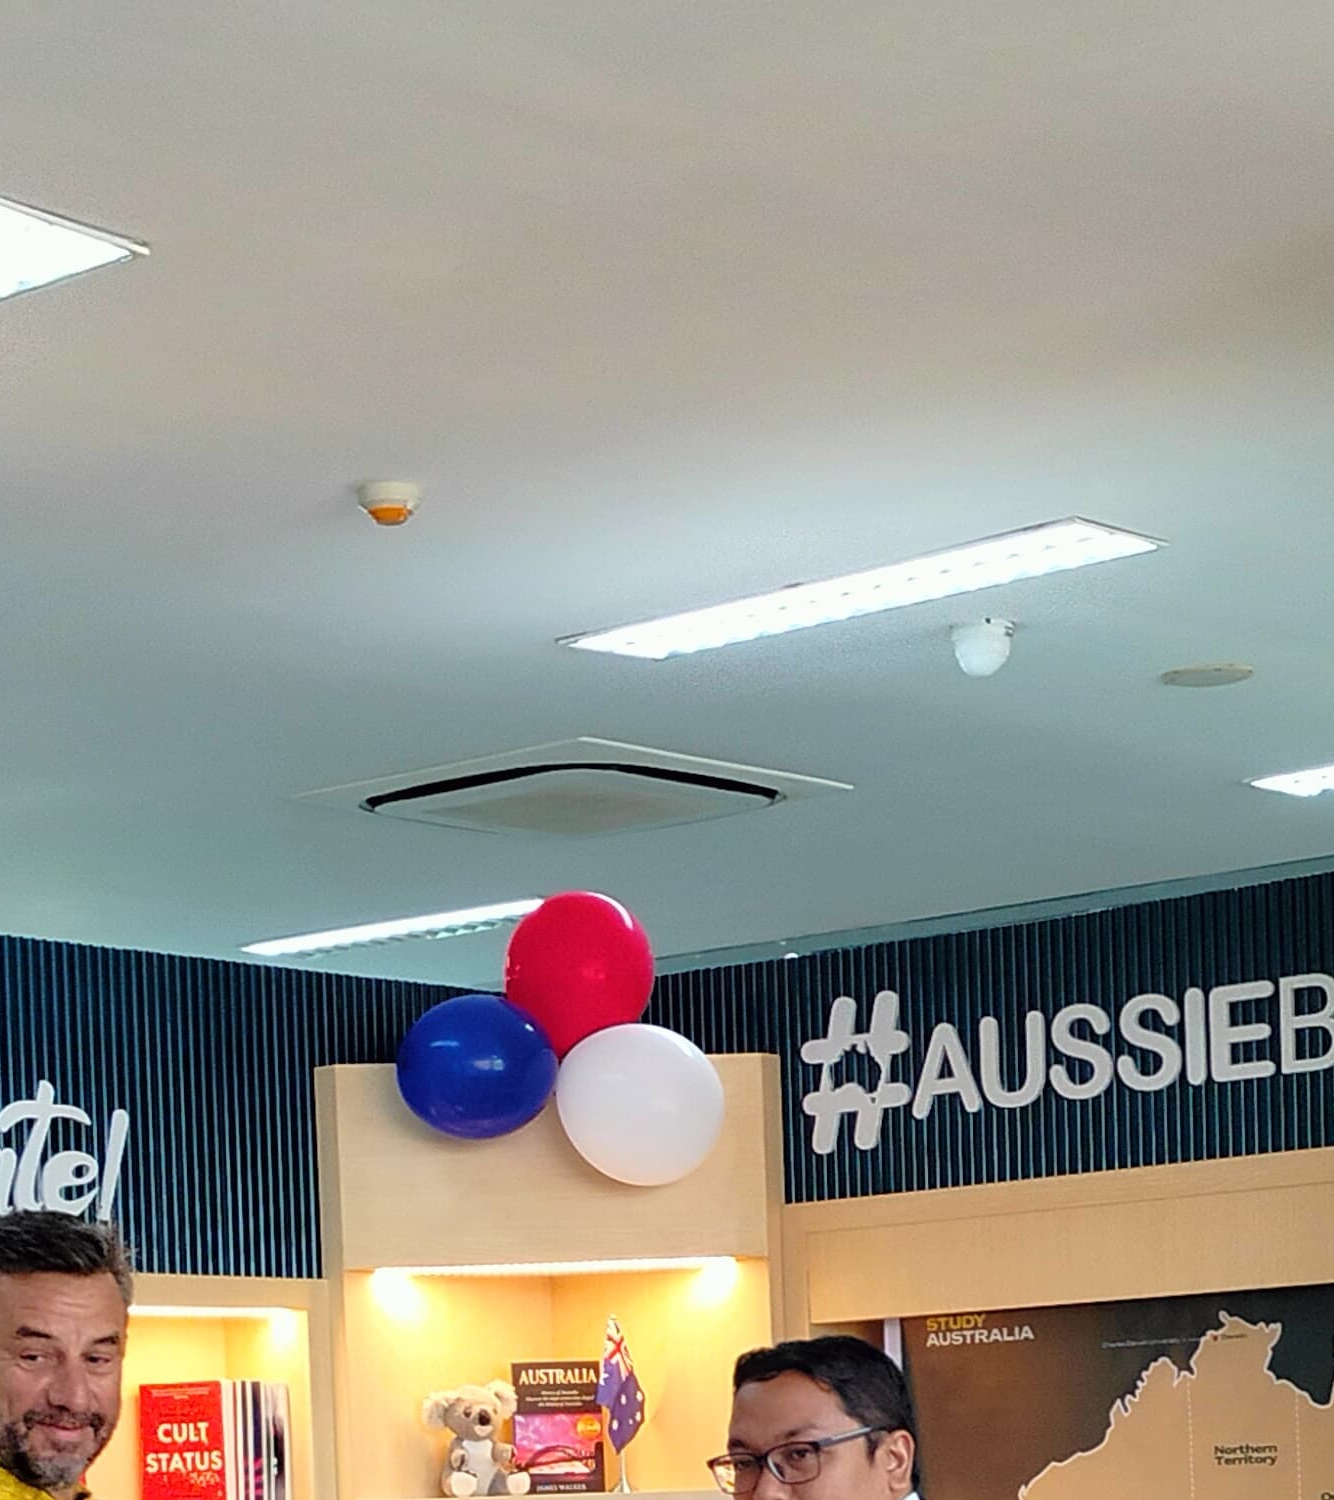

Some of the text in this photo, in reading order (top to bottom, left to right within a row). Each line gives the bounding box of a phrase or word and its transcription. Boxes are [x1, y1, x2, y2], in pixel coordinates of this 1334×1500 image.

[926, 1313, 986, 1331] STUDY
[926, 1325, 1035, 1347] AUSTRALIA
[519, 1367, 597, 1385] AUSTRALIA
[157, 1421, 209, 1445] CULT
[1214, 1443, 1278, 1455] Northern
[146, 1451, 222, 1475] STATUS
[1214, 1454, 1278, 1466] Territory
